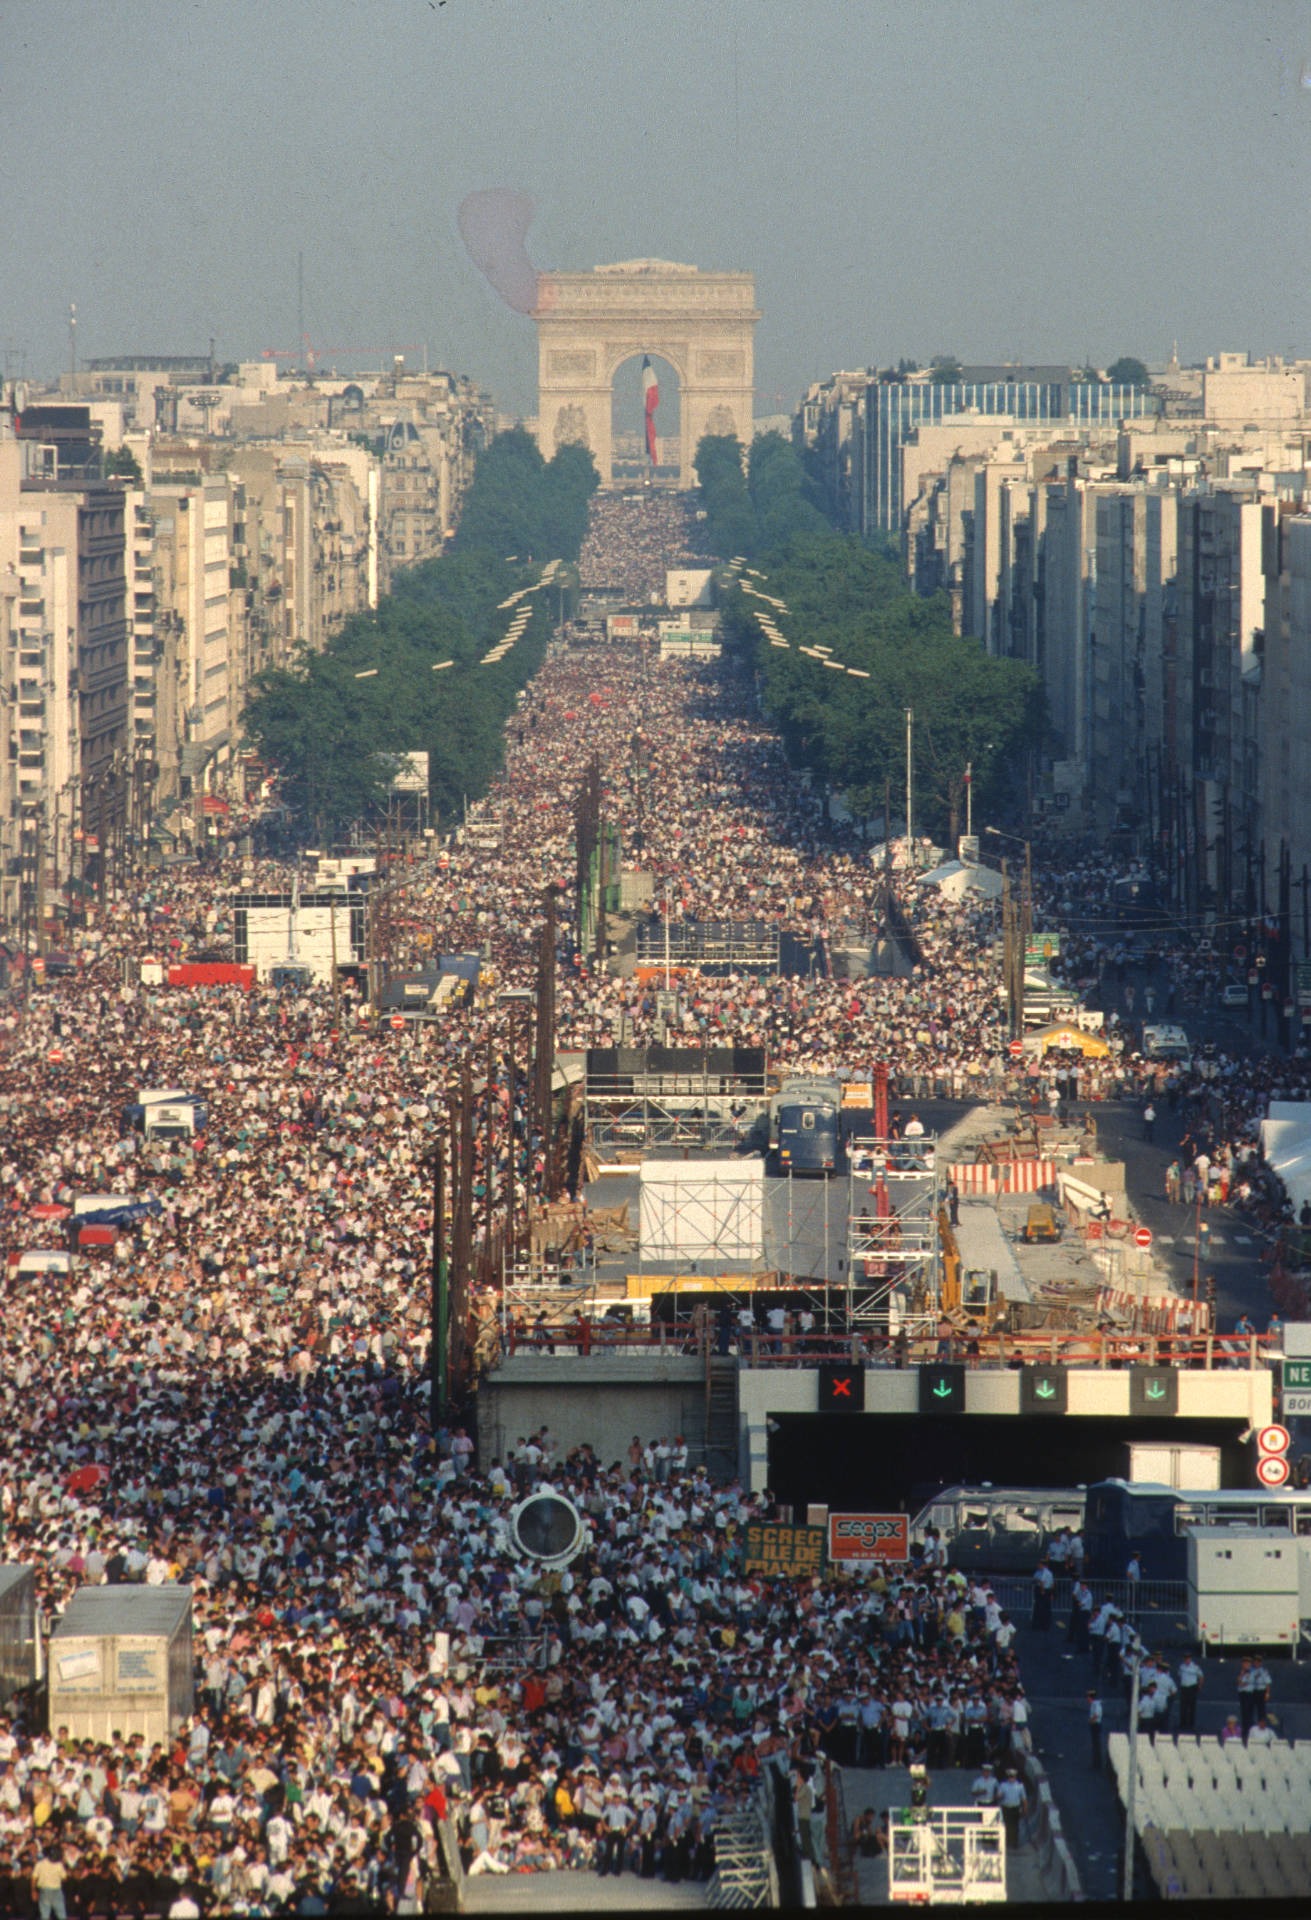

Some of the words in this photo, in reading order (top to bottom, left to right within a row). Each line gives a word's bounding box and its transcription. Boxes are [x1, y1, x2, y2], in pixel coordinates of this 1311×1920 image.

[1289, 1367, 1310, 1382] NE
[747, 1527, 823, 1545] SCREC
[763, 1544, 792, 1561] ILE
[794, 1547, 821, 1562] DE
